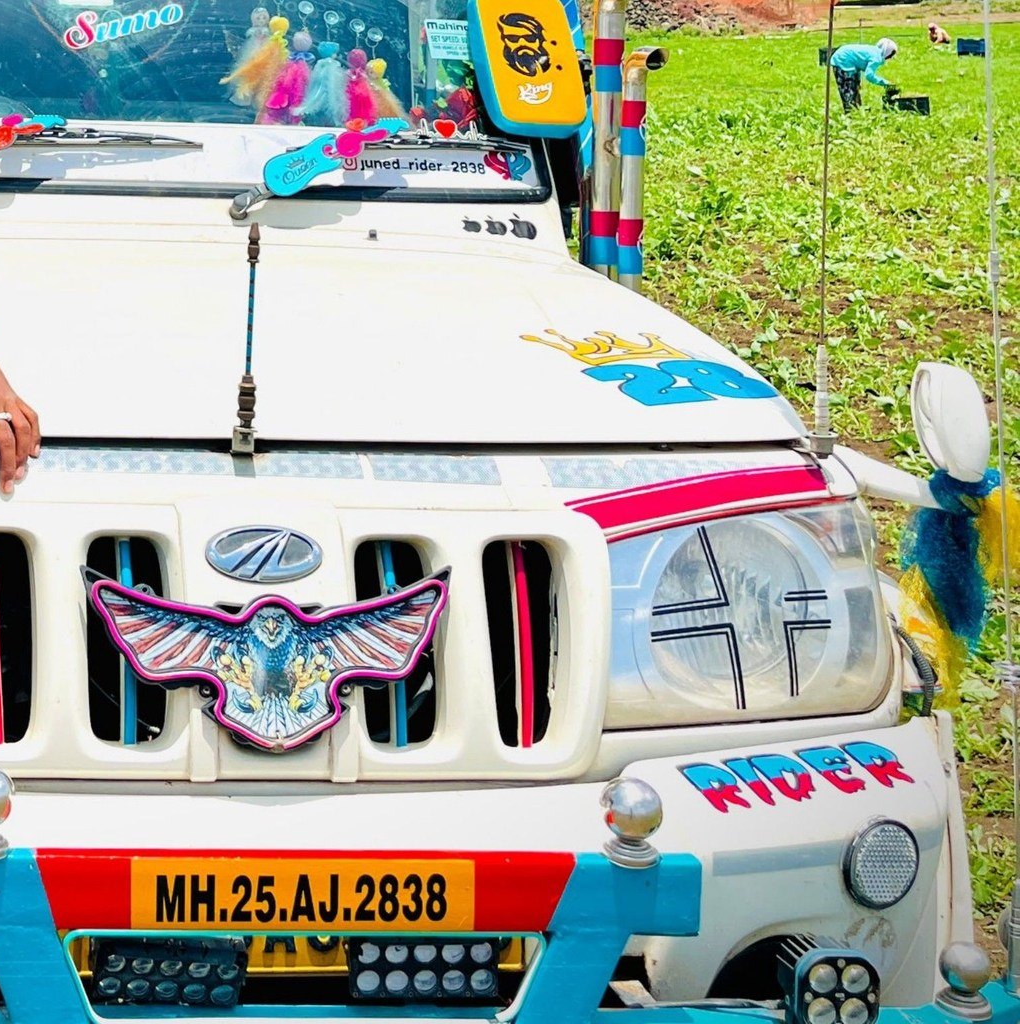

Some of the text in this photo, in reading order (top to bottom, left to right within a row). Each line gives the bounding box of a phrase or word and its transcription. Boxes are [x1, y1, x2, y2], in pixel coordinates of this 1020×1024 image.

[64, 3, 183, 49] Sumo
[680, 740, 914, 814] RIDER
[155, 873, 447, 924] MH.25.AJ.2838
